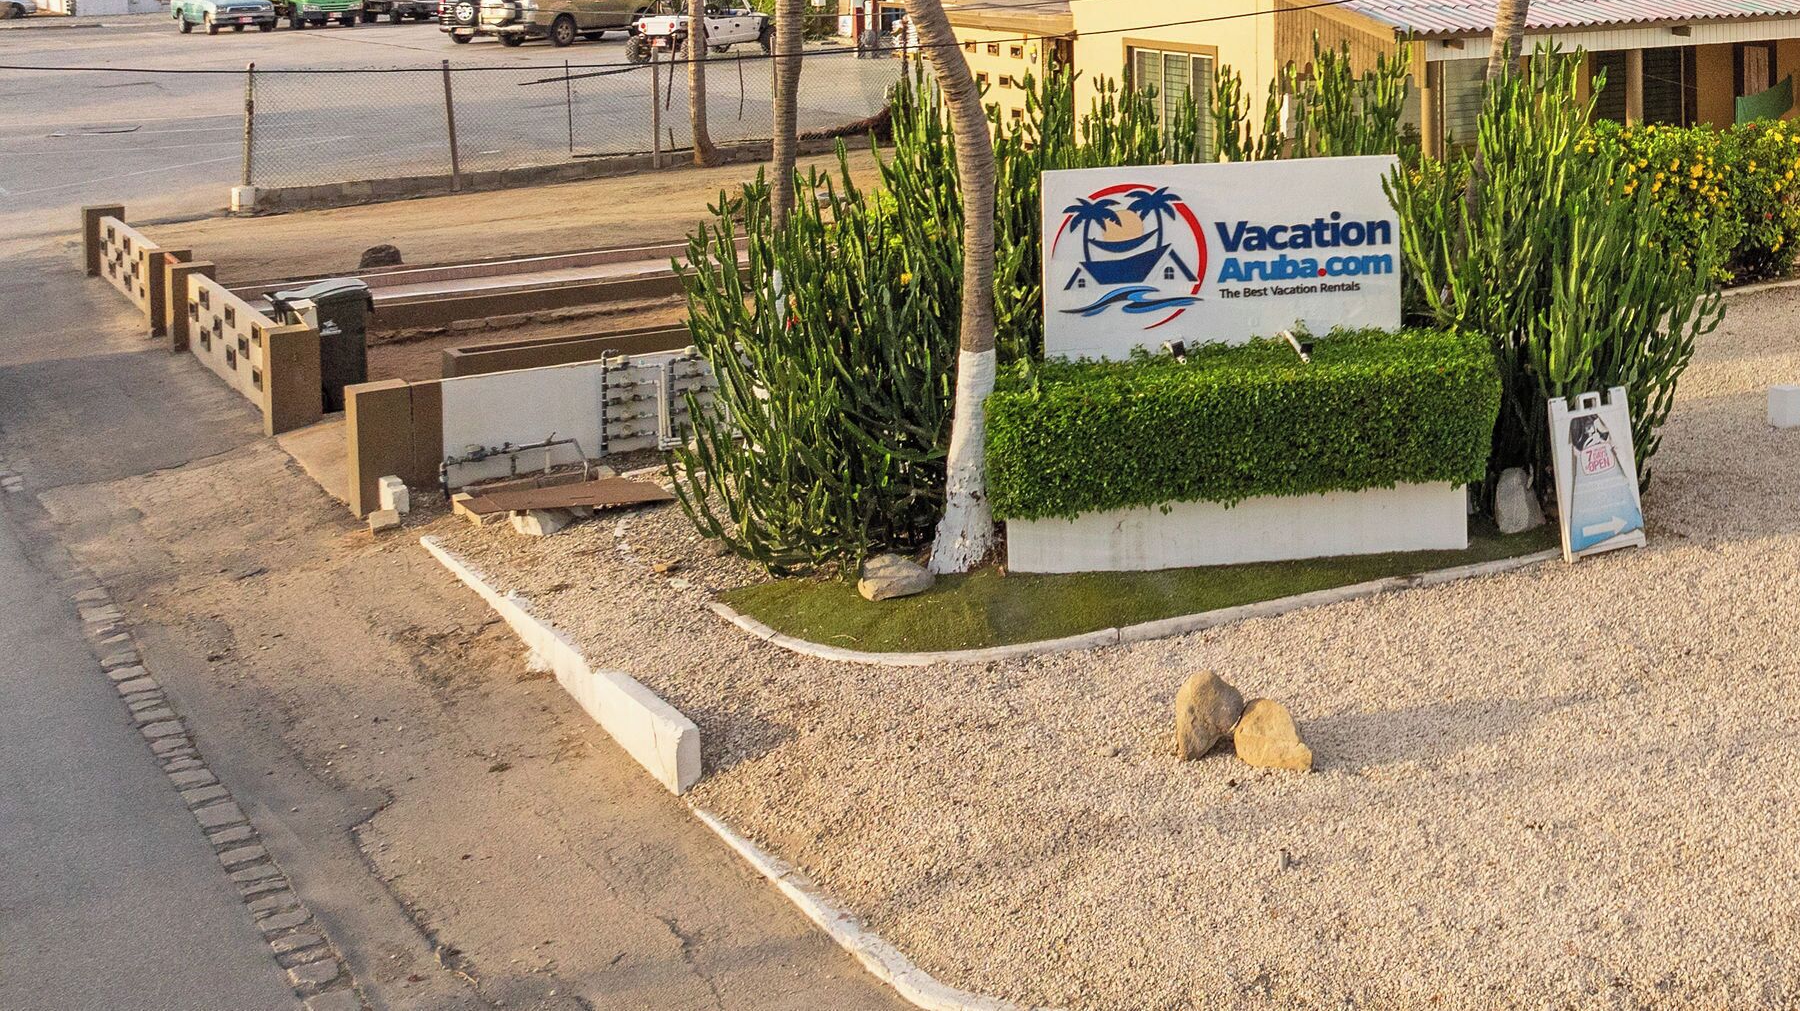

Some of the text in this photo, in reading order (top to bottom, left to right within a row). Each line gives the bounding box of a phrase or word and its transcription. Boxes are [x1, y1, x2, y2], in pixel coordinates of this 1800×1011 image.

[1214, 211, 1392, 253] Vacation
[1217, 253, 1393, 284] Aruba.com
[1219, 281, 1361, 299] The Best Vacation Rentals
[1586, 450, 1592, 462] 7
[1588, 457, 1610, 472] OPEN
